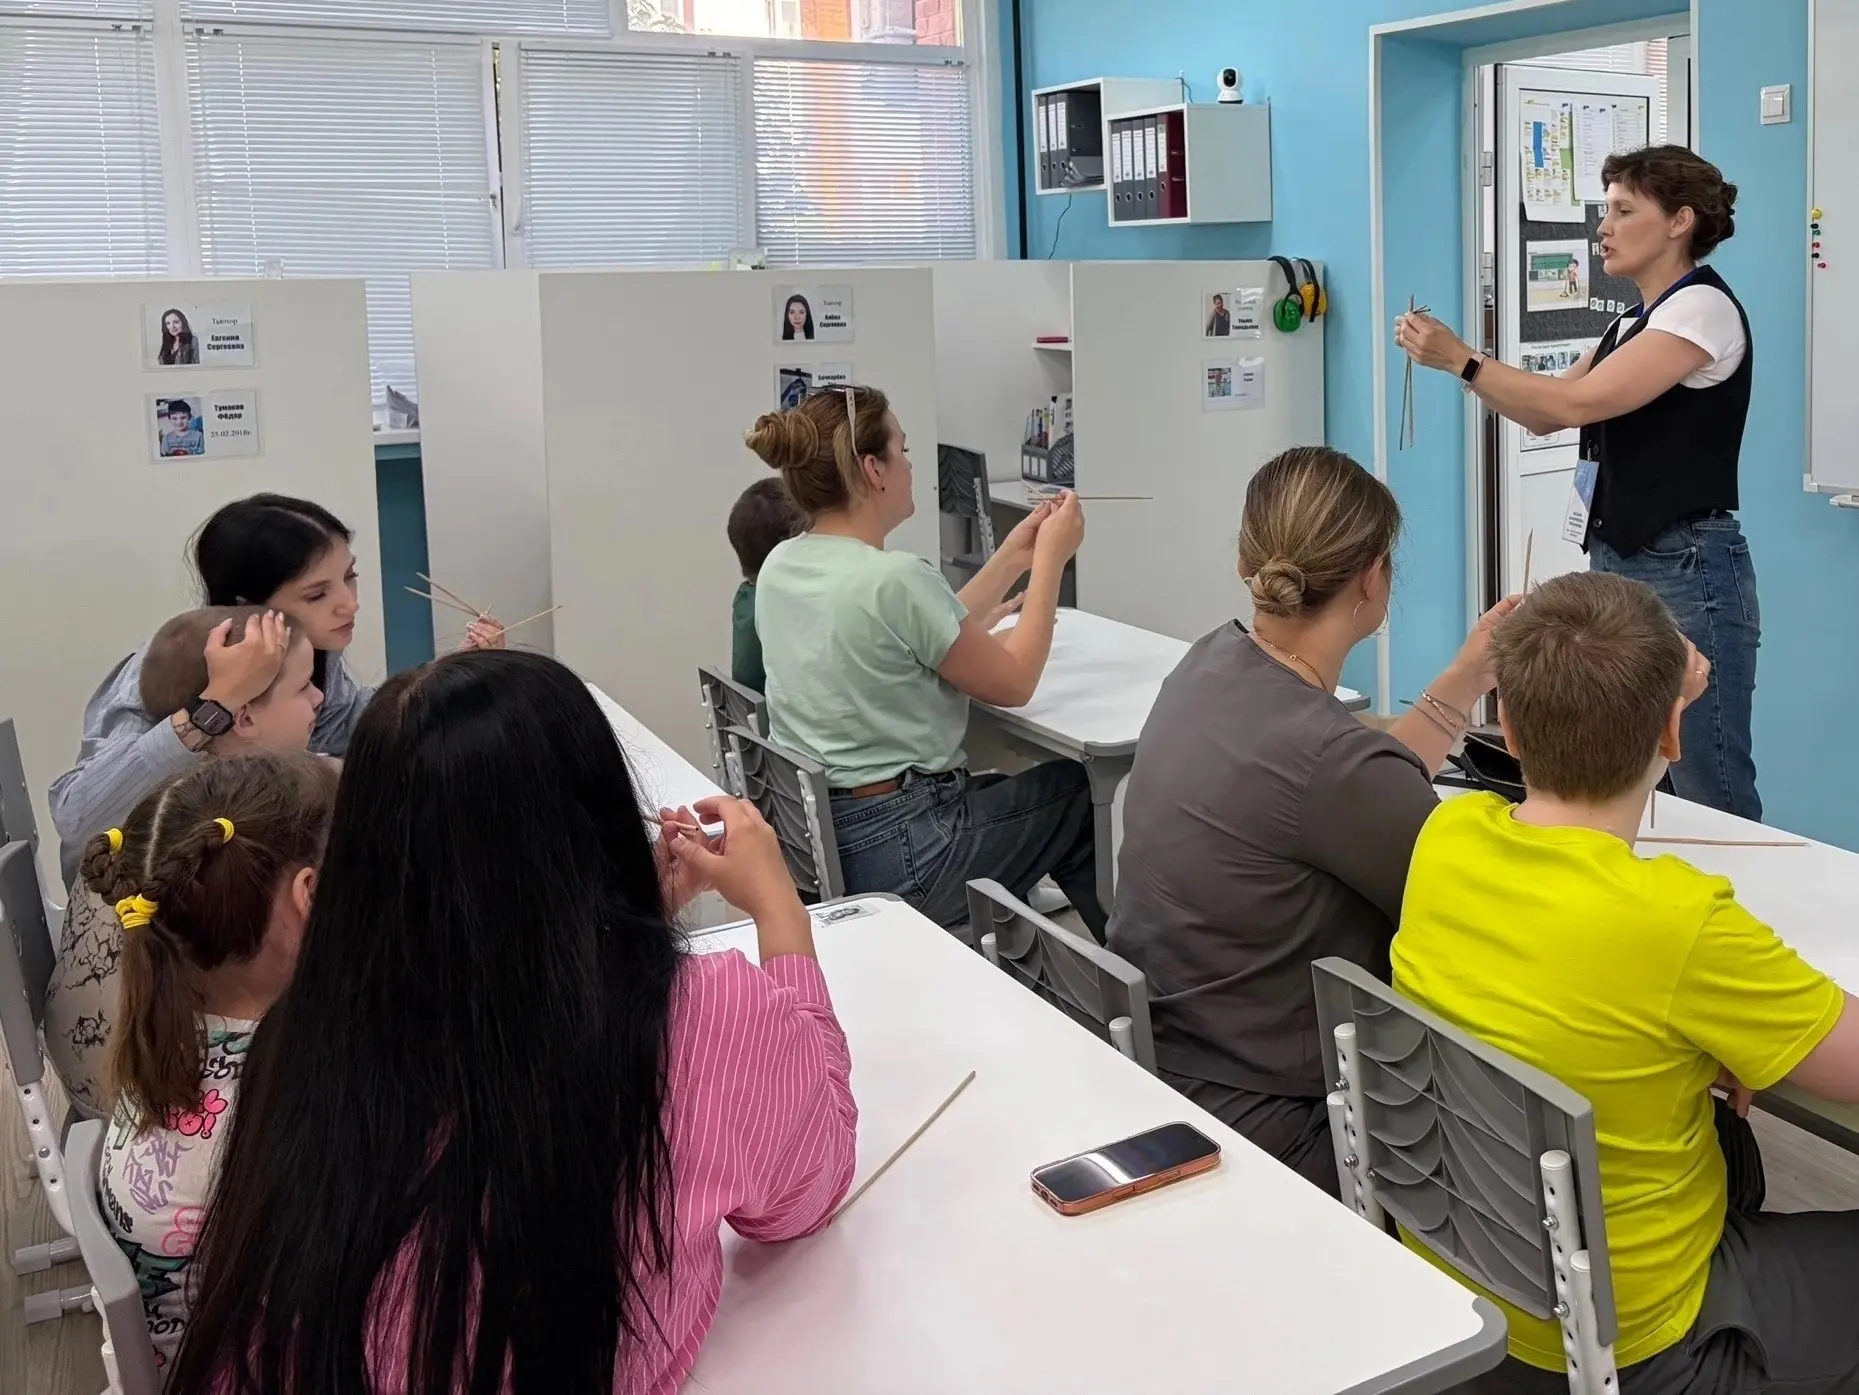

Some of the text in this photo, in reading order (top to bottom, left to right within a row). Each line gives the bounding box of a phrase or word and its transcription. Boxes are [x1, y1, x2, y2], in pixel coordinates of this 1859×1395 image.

[211, 317, 238, 326] Тьютор
[211, 334, 239, 342] Евгения
[207, 343, 245, 351] Сергеевна
[213, 404, 245, 412] Тумаков
[217, 412, 243, 421] Фёдор
